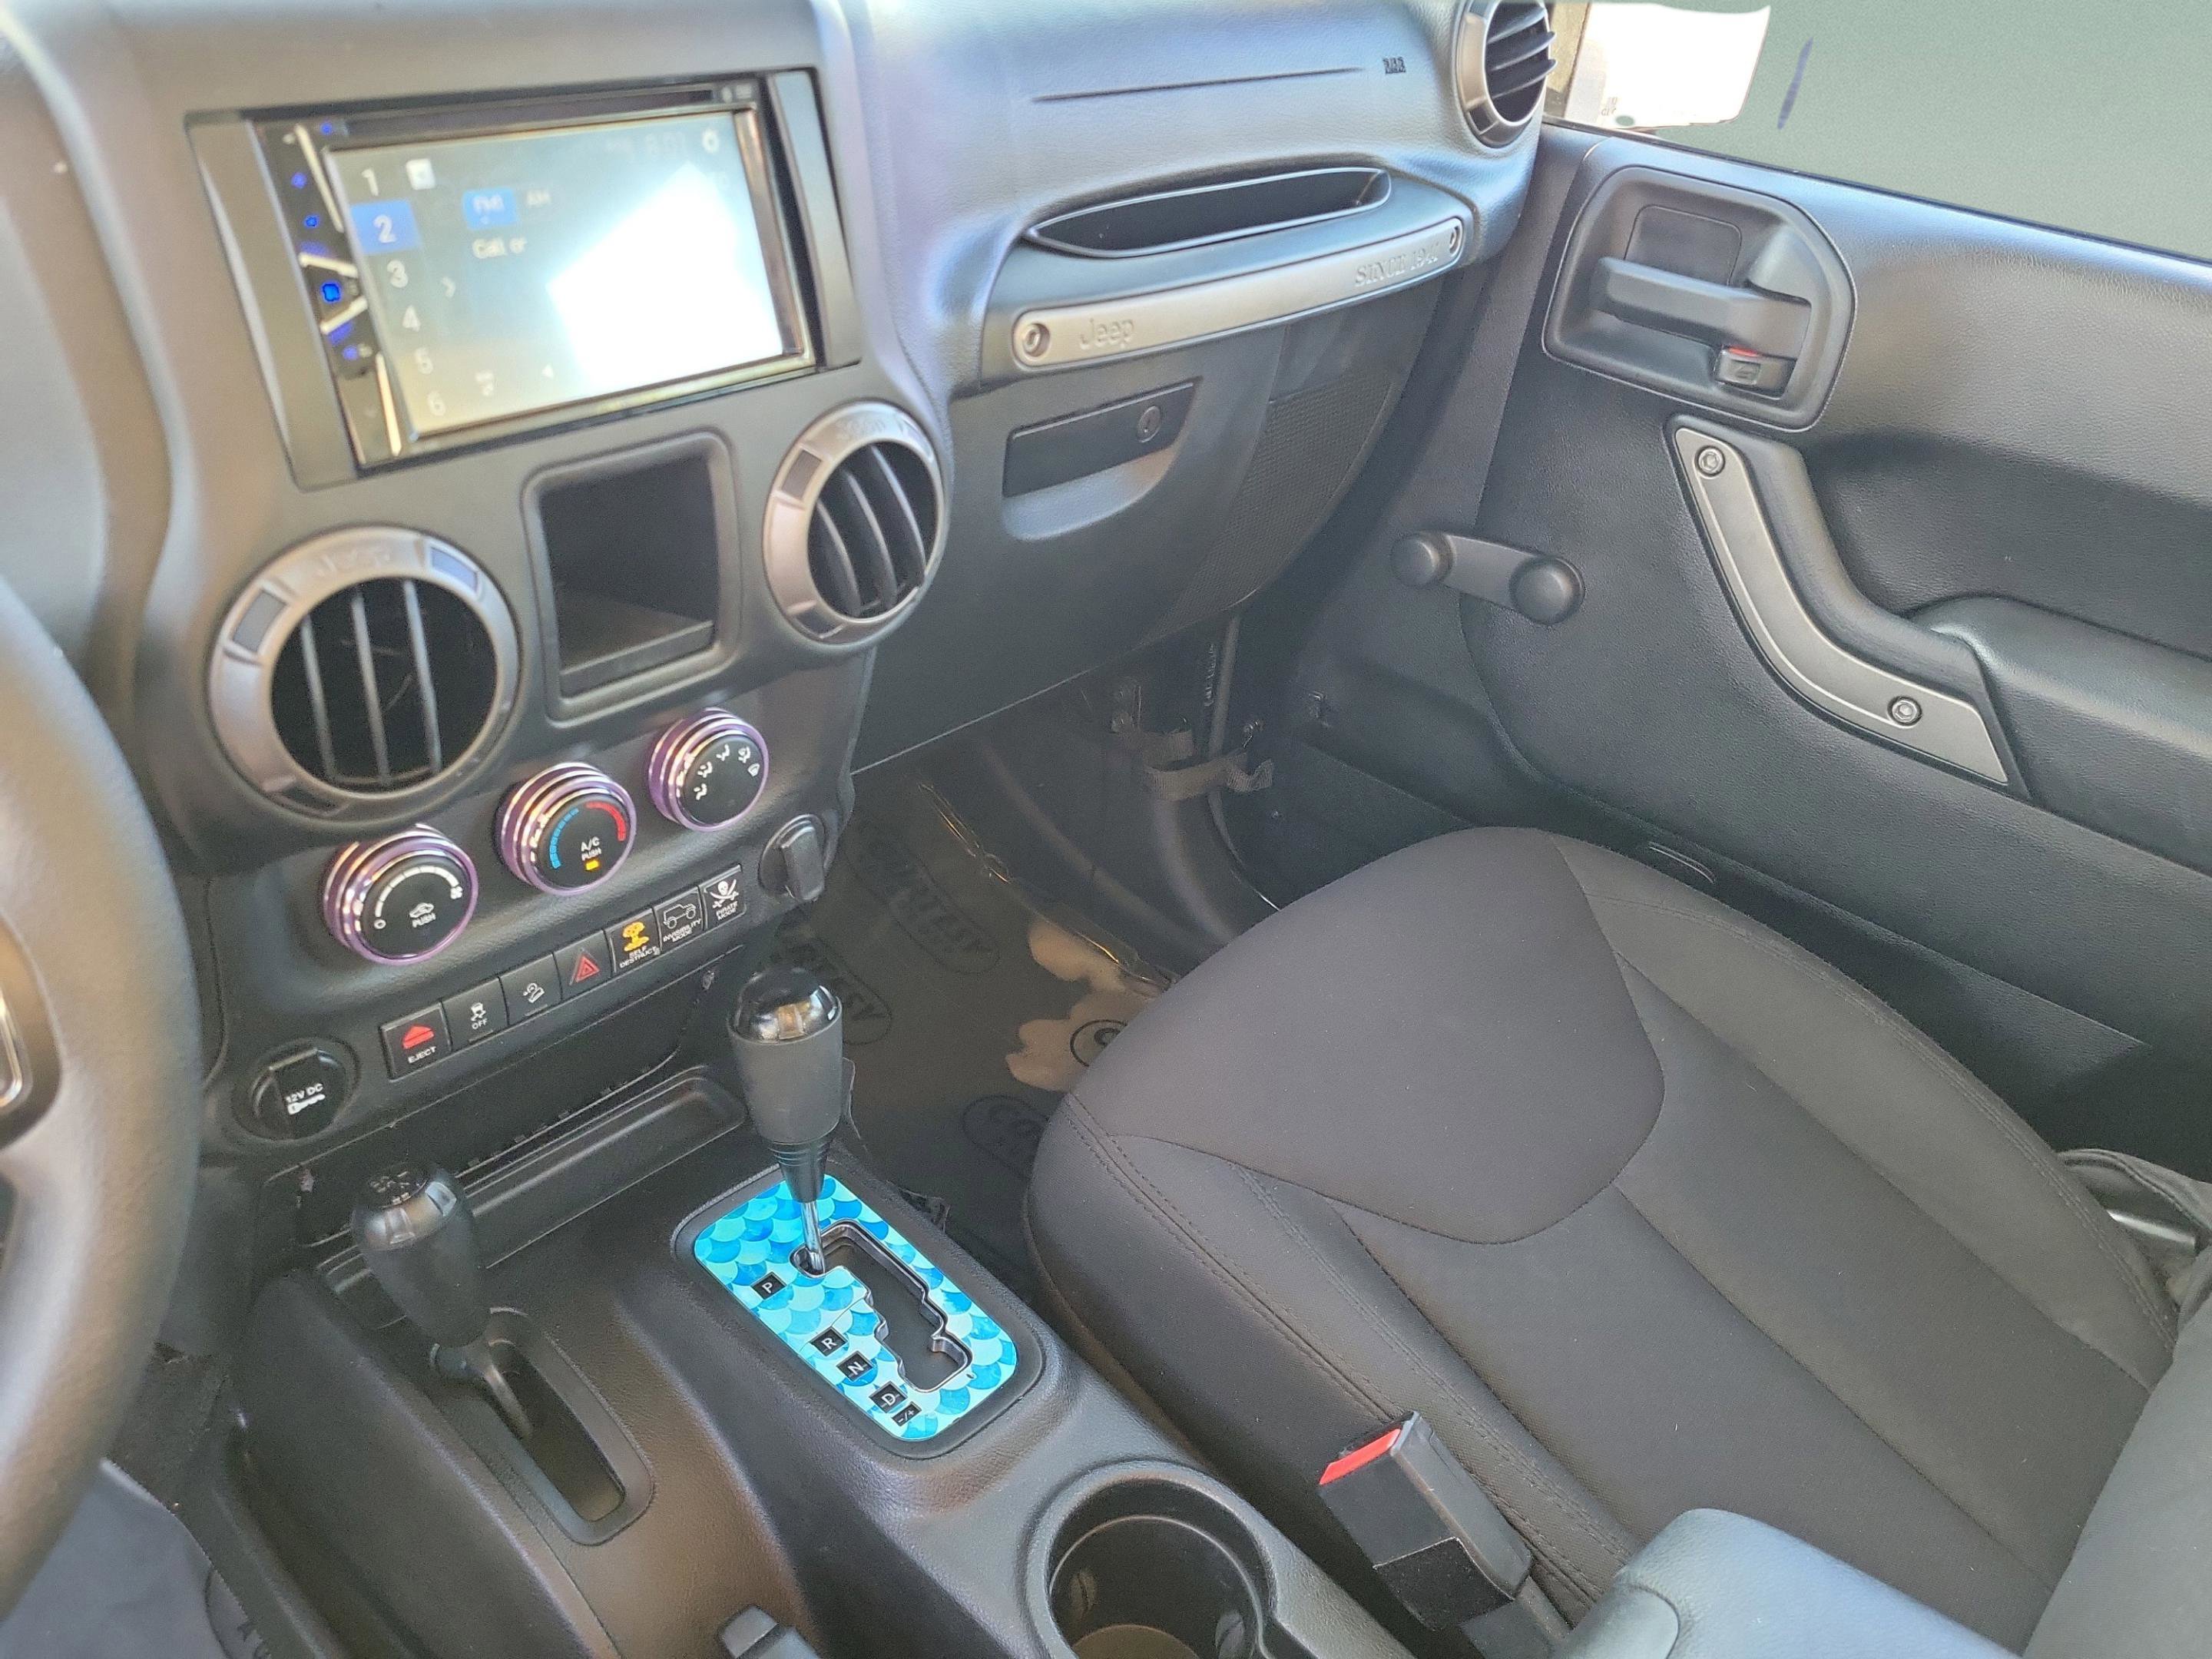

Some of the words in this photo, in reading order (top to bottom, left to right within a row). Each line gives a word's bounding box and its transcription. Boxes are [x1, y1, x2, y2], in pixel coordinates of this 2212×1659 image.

[361, 168, 379, 197] 1
[373, 214, 397, 243] 2
[386, 259, 409, 288] 3
[402, 305, 421, 332] 4
[1079, 317, 1134, 351] Jeep
[581, 836, 601, 852] A/C
[581, 847, 602, 861] PUSH
[412, 912, 437, 928] PUSH
[628, 945, 647, 958] SELF
[472, 1018, 488, 1030] OFF
[408, 1046, 437, 1064] EJECT
[286, 1090, 305, 1103] 12V
[306, 1083, 323, 1096] DC
[761, 1281, 773, 1294] P
[821, 1337, 836, 1349] R
[847, 1361, 864, 1375] N
[881, 1392, 896, 1406] D
